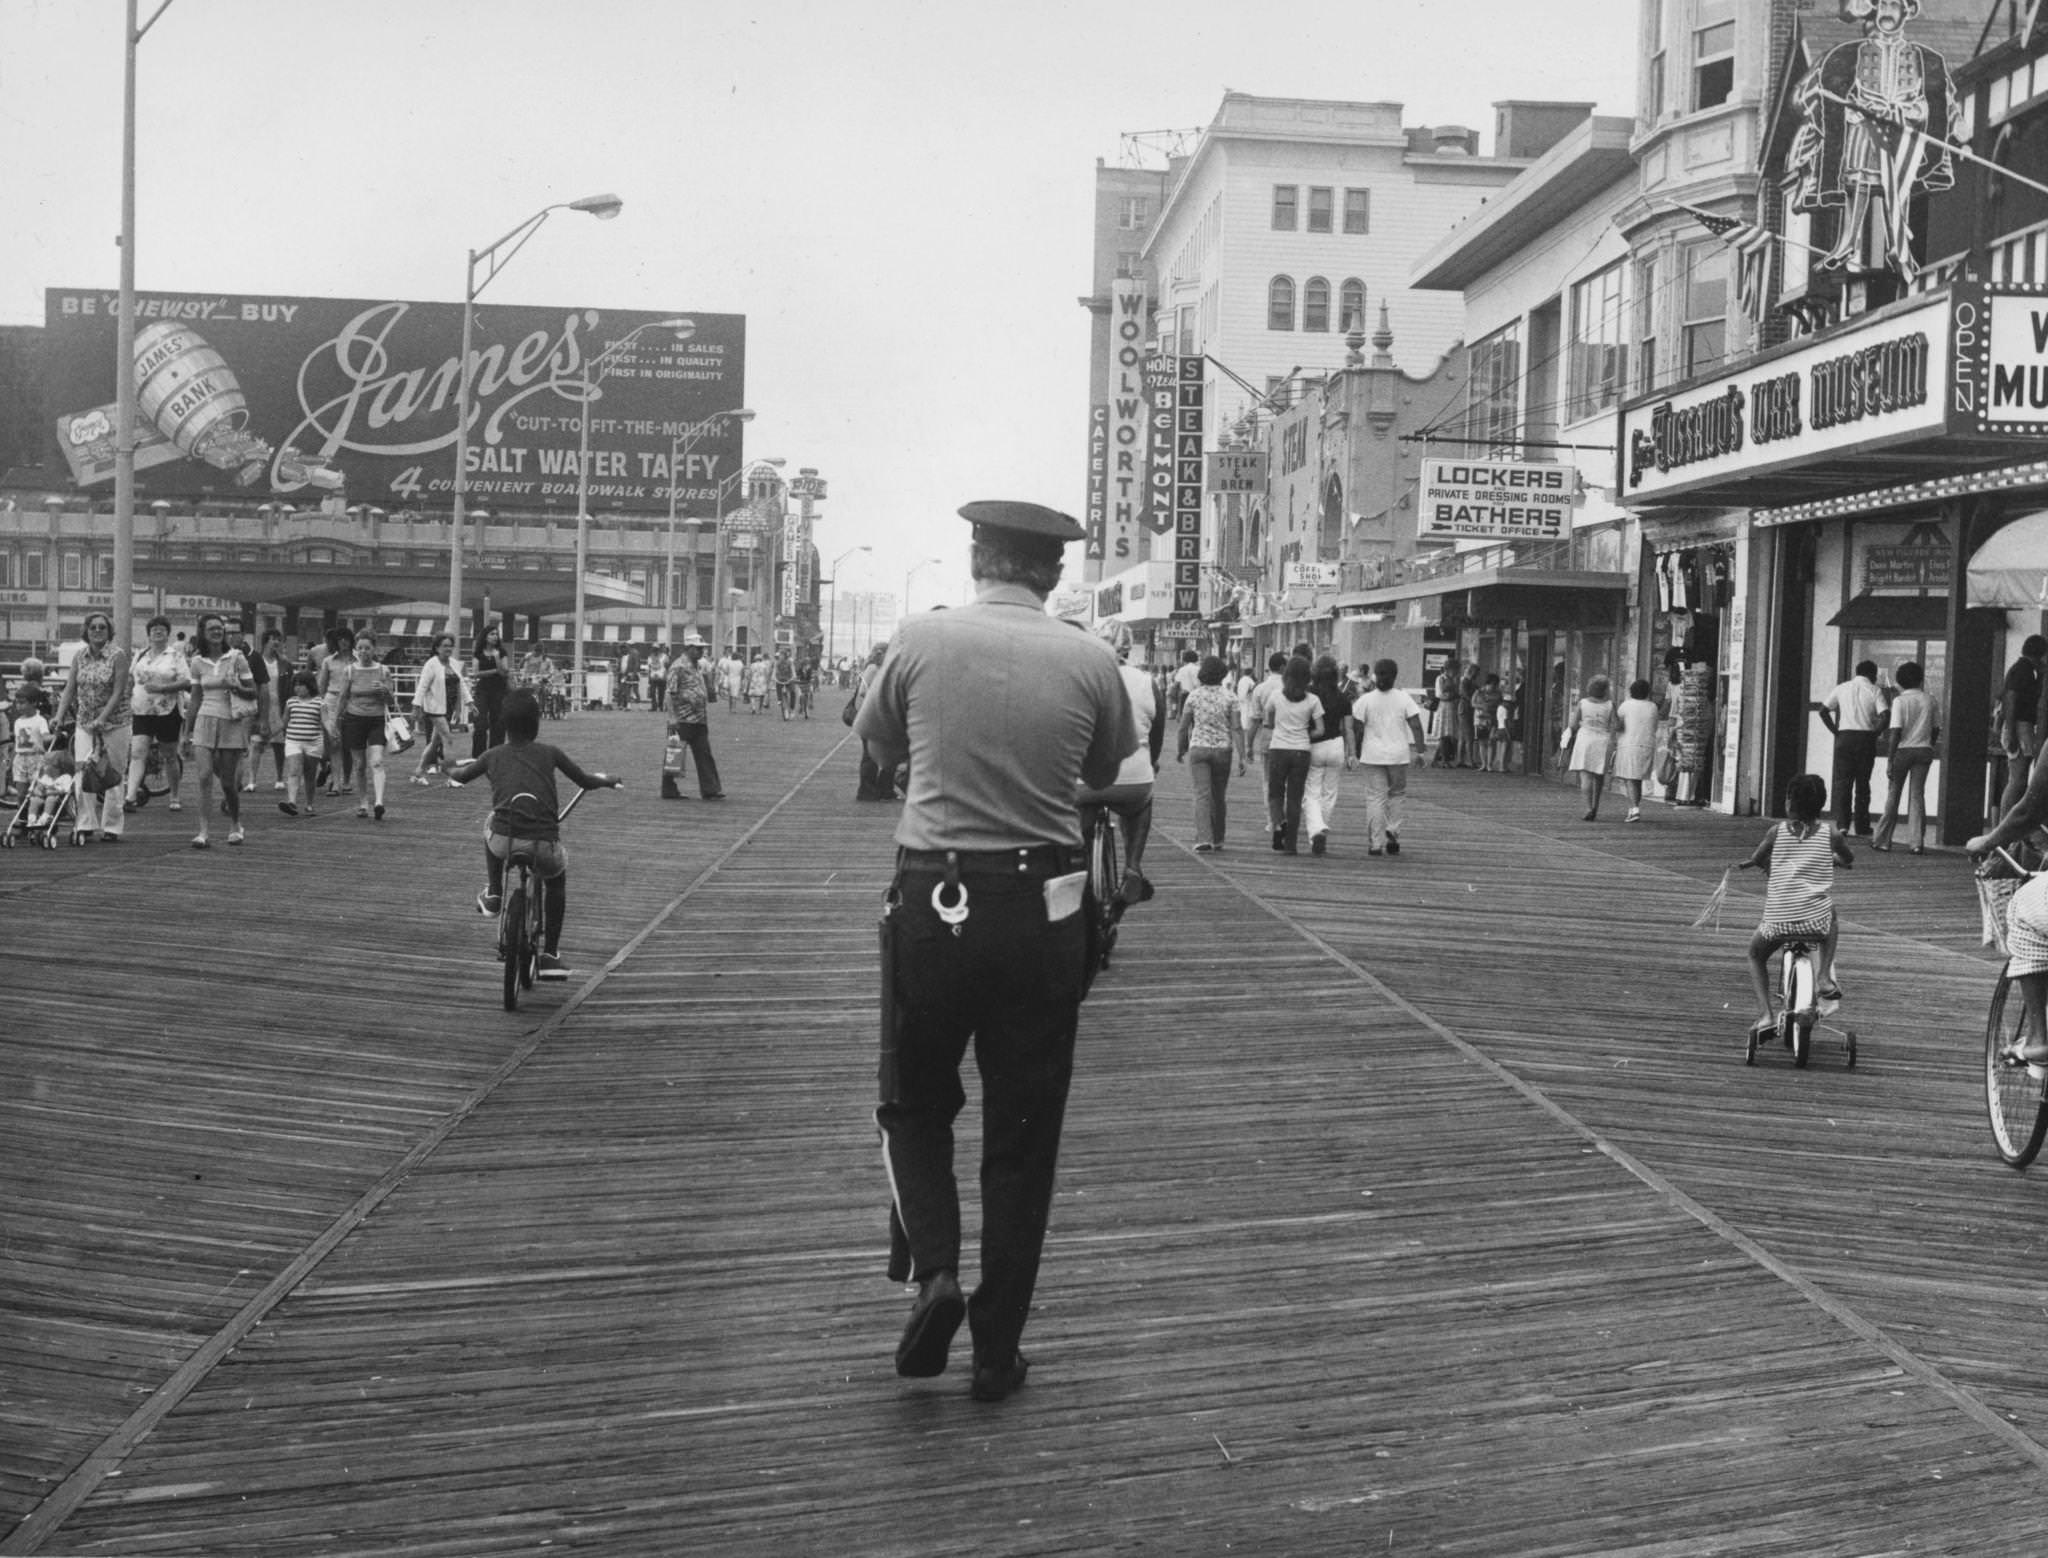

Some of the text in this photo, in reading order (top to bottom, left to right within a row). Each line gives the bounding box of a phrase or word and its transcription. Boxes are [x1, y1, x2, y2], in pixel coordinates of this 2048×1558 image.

[61, 297, 96, 315] BE
[241, 303, 299, 323] BUY
[671, 343, 685, 353] IN
[687, 344, 724, 354] SALES
[1955, 302, 1976, 412] OPEN
[676, 356, 723, 367] QUALITY
[1145, 354, 1177, 374] HOTE
[170, 376, 217, 418] BANK
[270, 301, 604, 490] James'
[1115, 294, 1143, 557] WOOLWORTH'S
[464, 446, 720, 481] SALT WATER TAFFY
[389, 465, 424, 499] 4
[1437, 465, 1563, 489] LOCKERS
[1427, 488, 1571, 505] PRIVATE DRESSING ROOMS
[1435, 503, 1562, 527] BATHERS
[1453, 523, 1541, 536] TICKET OFFICE
